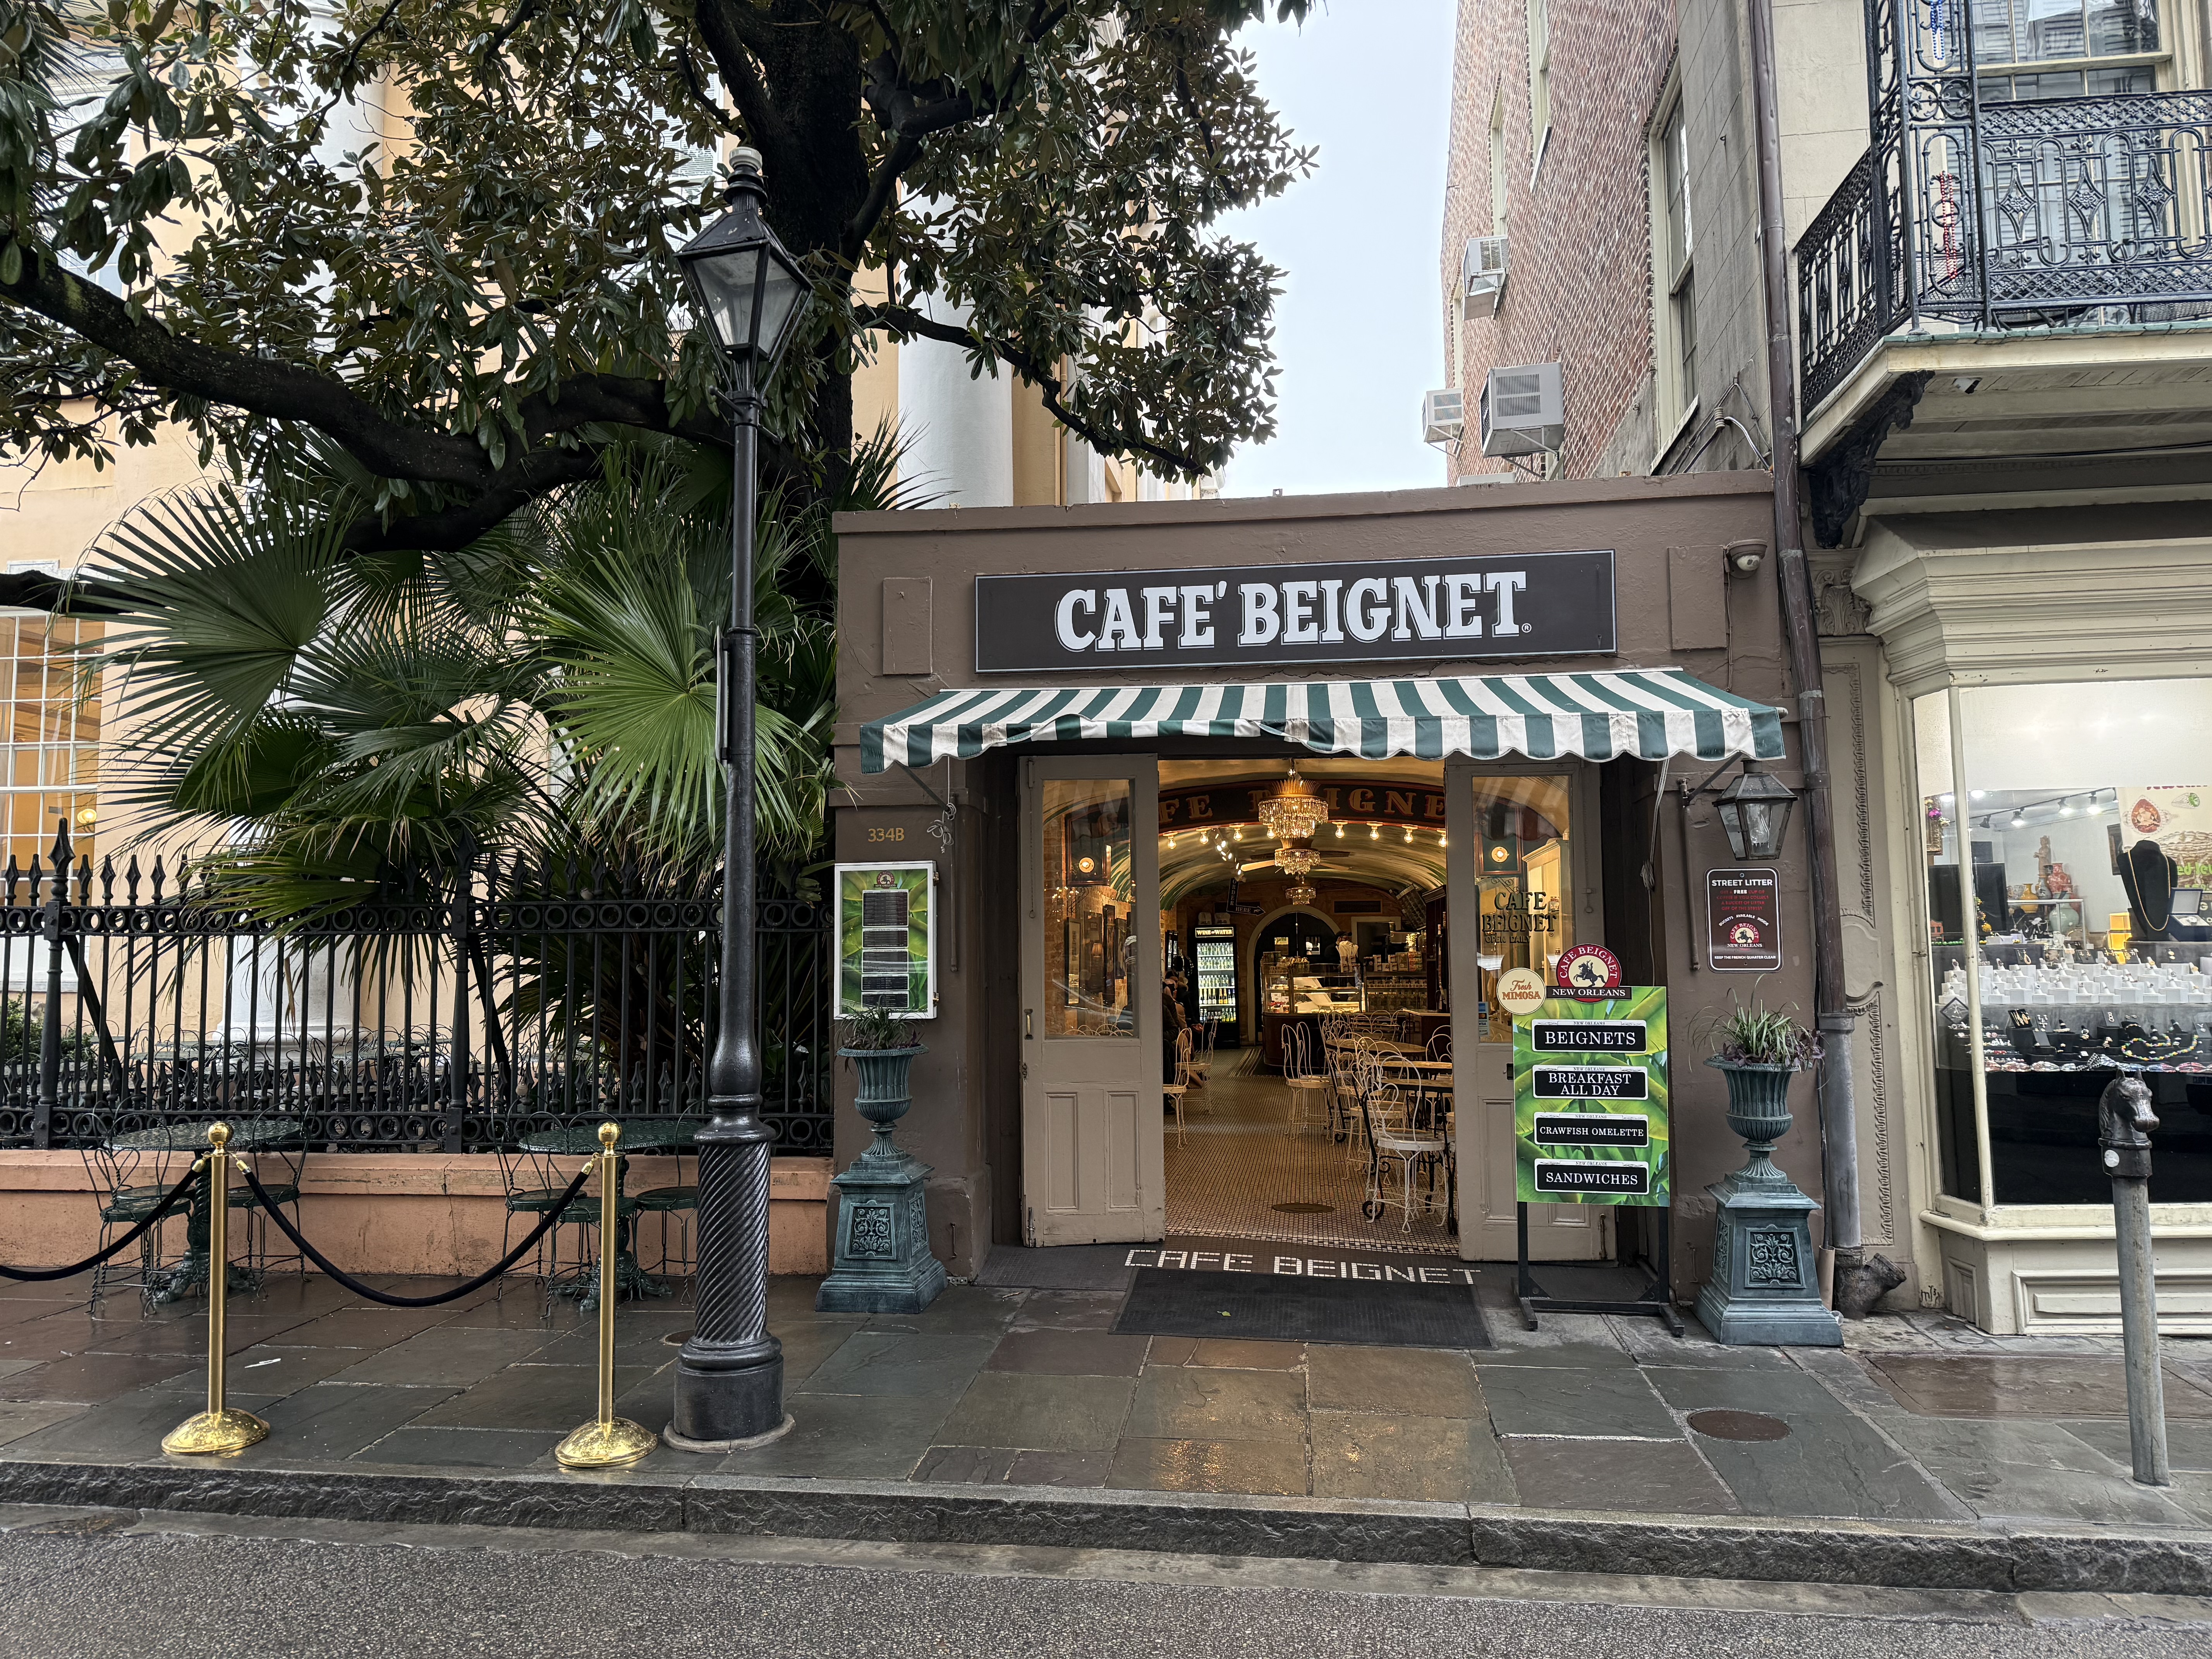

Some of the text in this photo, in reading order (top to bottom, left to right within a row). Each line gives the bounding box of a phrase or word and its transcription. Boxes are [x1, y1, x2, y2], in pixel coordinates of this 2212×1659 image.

[868, 828, 905, 842] 334B
[1494, 891, 1547, 910] CAFE
[1719, 915, 1734, 926] BUCKETS
[1739, 923, 1759, 939] BEIGNET
[1510, 935, 1531, 943] DAILY
[1559, 946, 1618, 979] CAFE BEIGNET
[1510, 979, 1532, 992] Fresh
[1502, 991, 1542, 1000] MIMOSA
[1544, 1031, 1636, 1045] BEIGNETS
[1548, 1073, 1631, 1084] BREAKFAST
[1561, 1085, 1620, 1096] ALL DAY
[1539, 1127, 1644, 1137] CRAWFISH OMELETTE
[1546, 1172, 1638, 1185] SANDWICHES
[1124, 1249, 1481, 1285] CAFE BEIGNET
